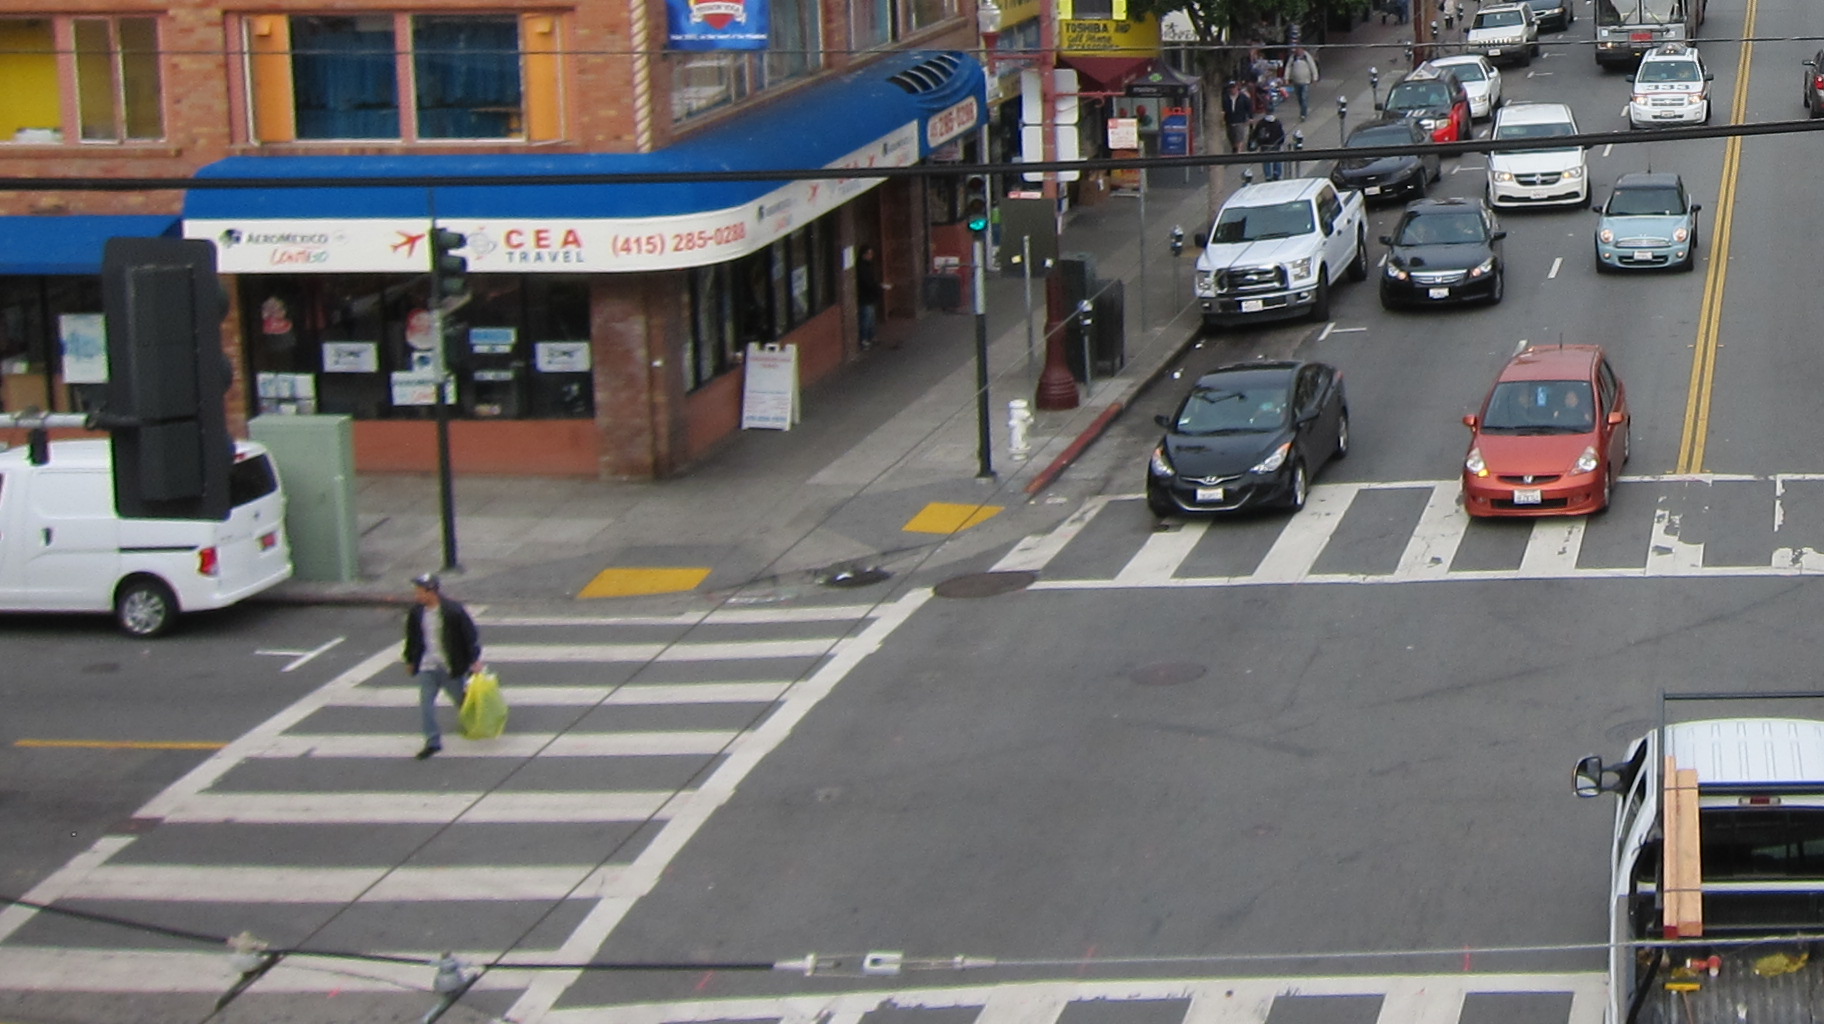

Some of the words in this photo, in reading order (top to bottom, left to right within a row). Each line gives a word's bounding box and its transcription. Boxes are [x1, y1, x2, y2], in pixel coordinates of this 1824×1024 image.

[1065, 23, 1108, 33] TOSHIBA
[504, 228, 583, 249] CEA
[612, 234, 666, 257] (415)
[505, 251, 585, 263] TRAVEL
